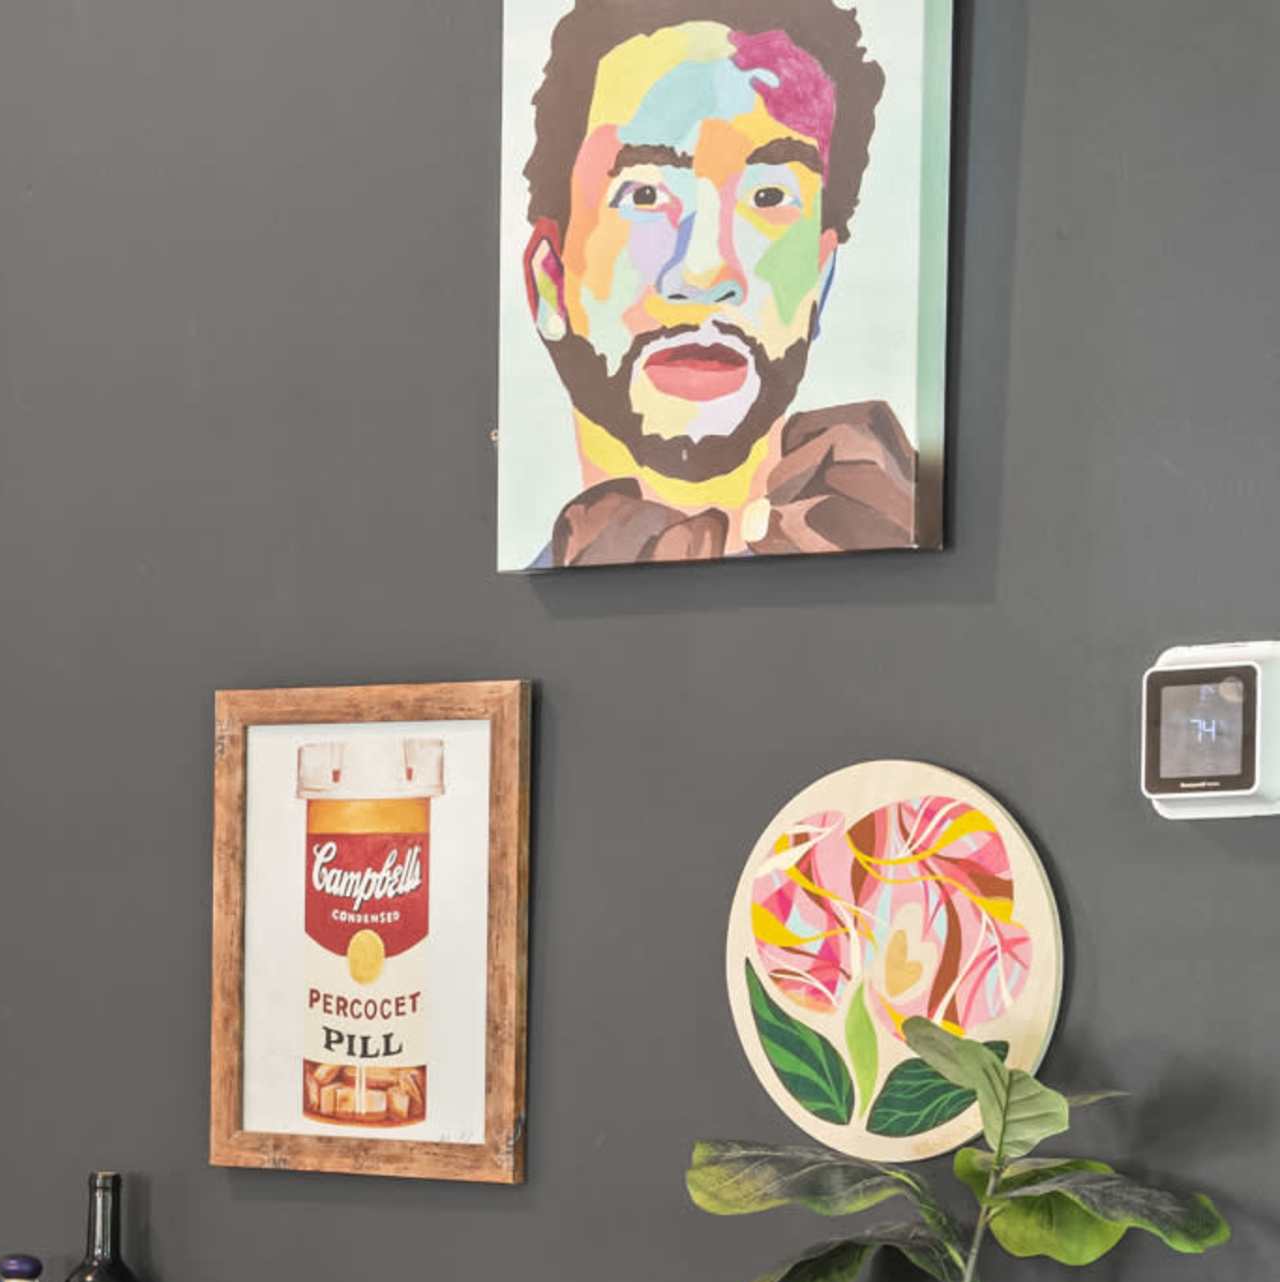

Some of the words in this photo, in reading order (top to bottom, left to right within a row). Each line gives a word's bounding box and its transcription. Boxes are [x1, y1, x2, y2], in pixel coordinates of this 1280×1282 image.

[1190, 718, 1216, 744] 74
[332, 908, 401, 924] CONDENSED
[308, 988, 422, 1020] PERCOCET
[322, 1025, 404, 1059] PILL
